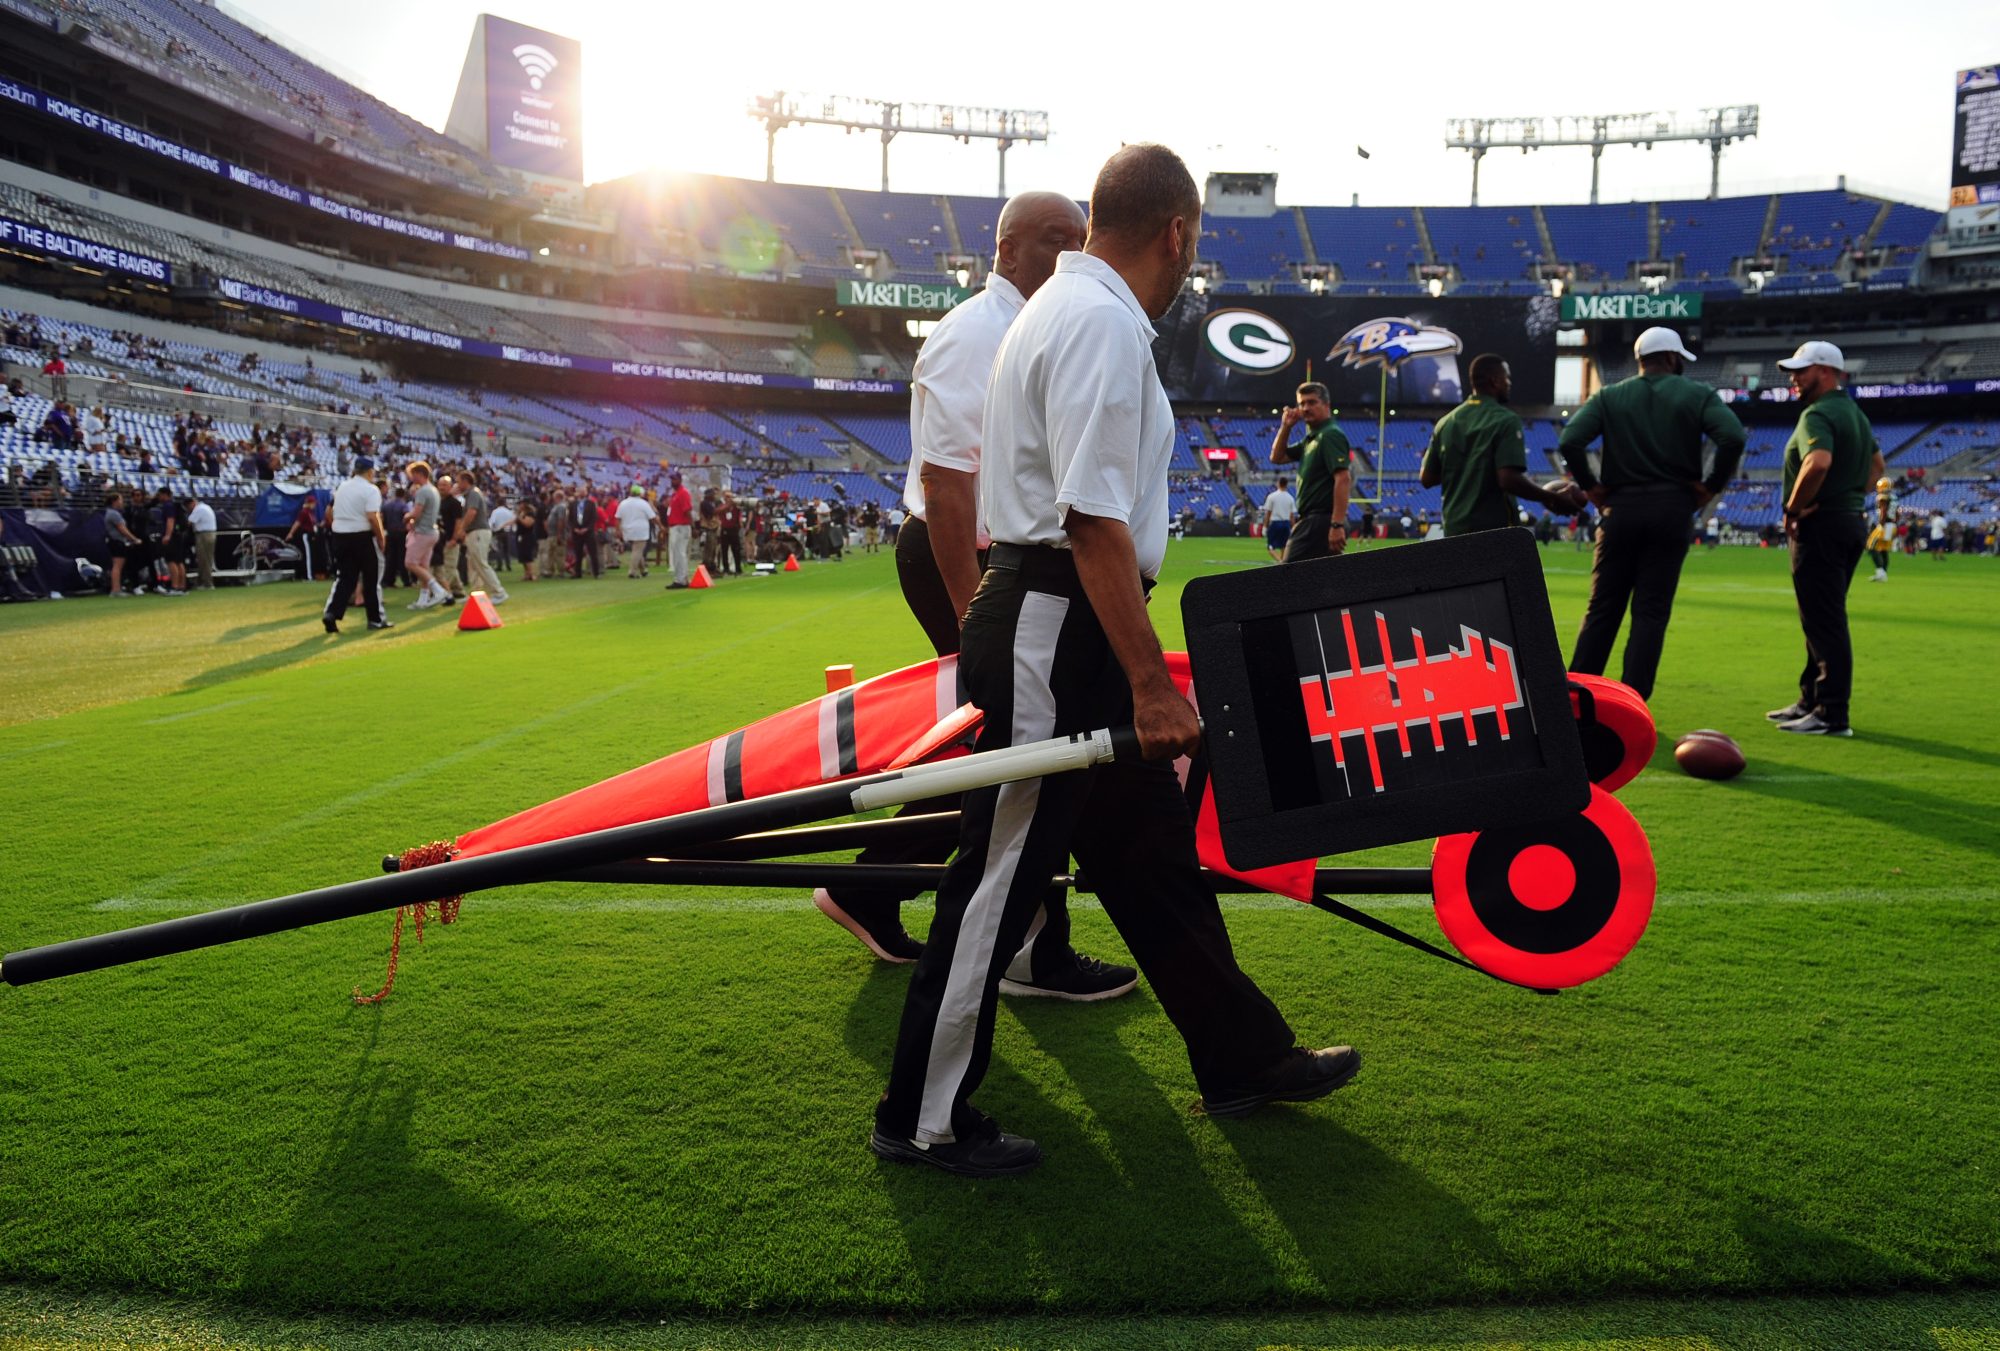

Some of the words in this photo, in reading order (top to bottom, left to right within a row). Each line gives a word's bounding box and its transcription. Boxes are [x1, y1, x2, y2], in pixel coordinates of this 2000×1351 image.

[0, 82, 36, 106] tadium
[46, 97, 82, 124] HOME
[83, 112, 100, 128] OF
[101, 118, 123, 139] THE
[124, 127, 181, 160] BALTIMORE
[182, 149, 220, 174] RAVENS
[309, 194, 349, 219] WELCOME
[350, 207, 362, 223] TO
[383, 217, 407, 233] BANK
[407, 223, 445, 243] STADIUM
[15, 224, 44, 248] THE
[46, 233, 117, 267] BALTIMORE
[119, 252, 165, 279] RAVENS
[850, 281, 906, 307] M&T
[907, 284, 959, 308] Bank
[1574, 294, 1632, 320] M&T
[1632, 293, 1689, 318] Bank
[341, 310, 380, 332] WELCOME
[381, 319, 394, 335] TO
[411, 325, 432, 344] BANK
[432, 330, 462, 350] STADIUM
[612, 362, 641, 376] HOME
[641, 364, 653, 377] OF
[657, 366, 674, 379] THE
[674, 367, 726, 383] BALTIMORE
[727, 372, 763, 386] RAVENS
[1975, 380, 2000, 392] HOM
[1907, 383, 1948, 396] Stadium
